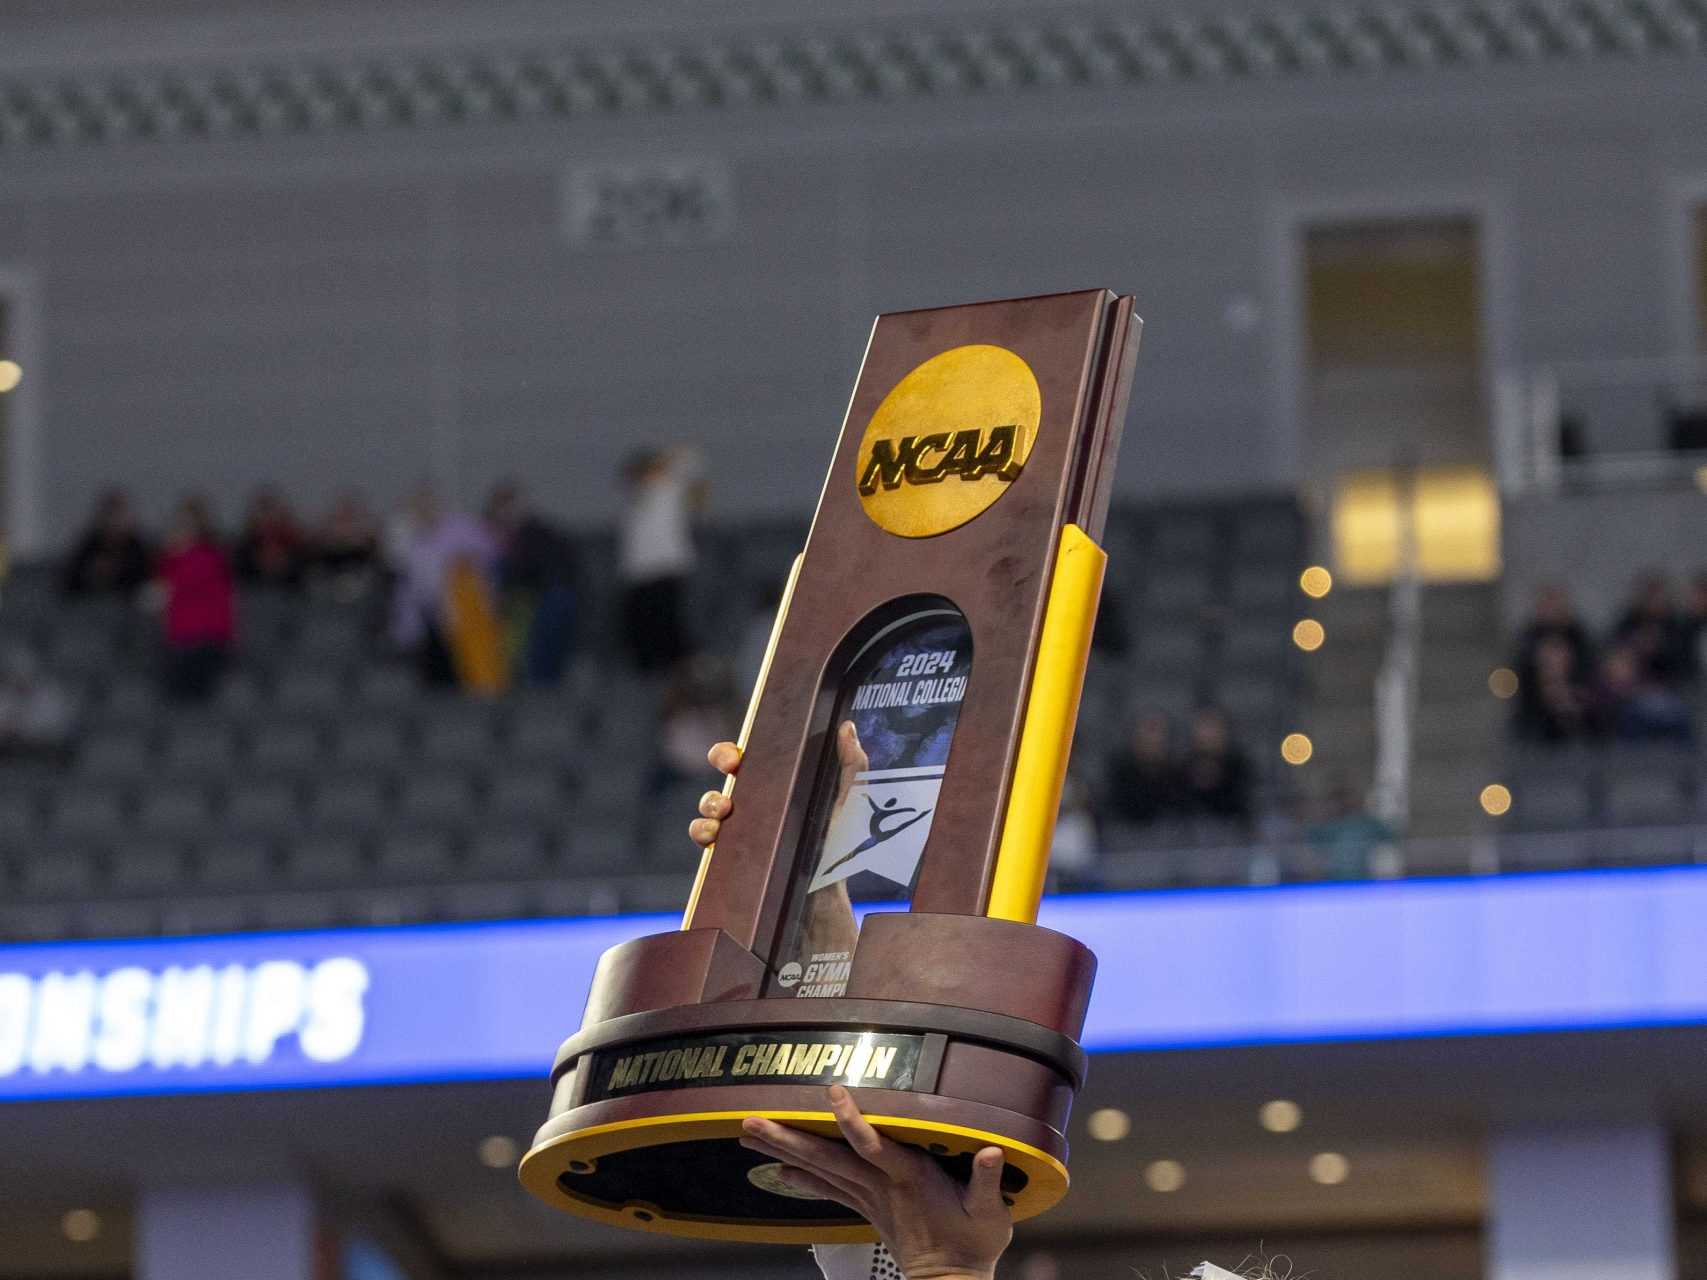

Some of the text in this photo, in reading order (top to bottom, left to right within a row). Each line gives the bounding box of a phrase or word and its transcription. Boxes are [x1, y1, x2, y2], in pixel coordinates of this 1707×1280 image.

[859, 425, 1026, 497] NCAA
[896, 650, 957, 677] 2024
[851, 681, 912, 710] NATIONAL
[607, 1043, 898, 1090] NATIONAL CHAMPION
